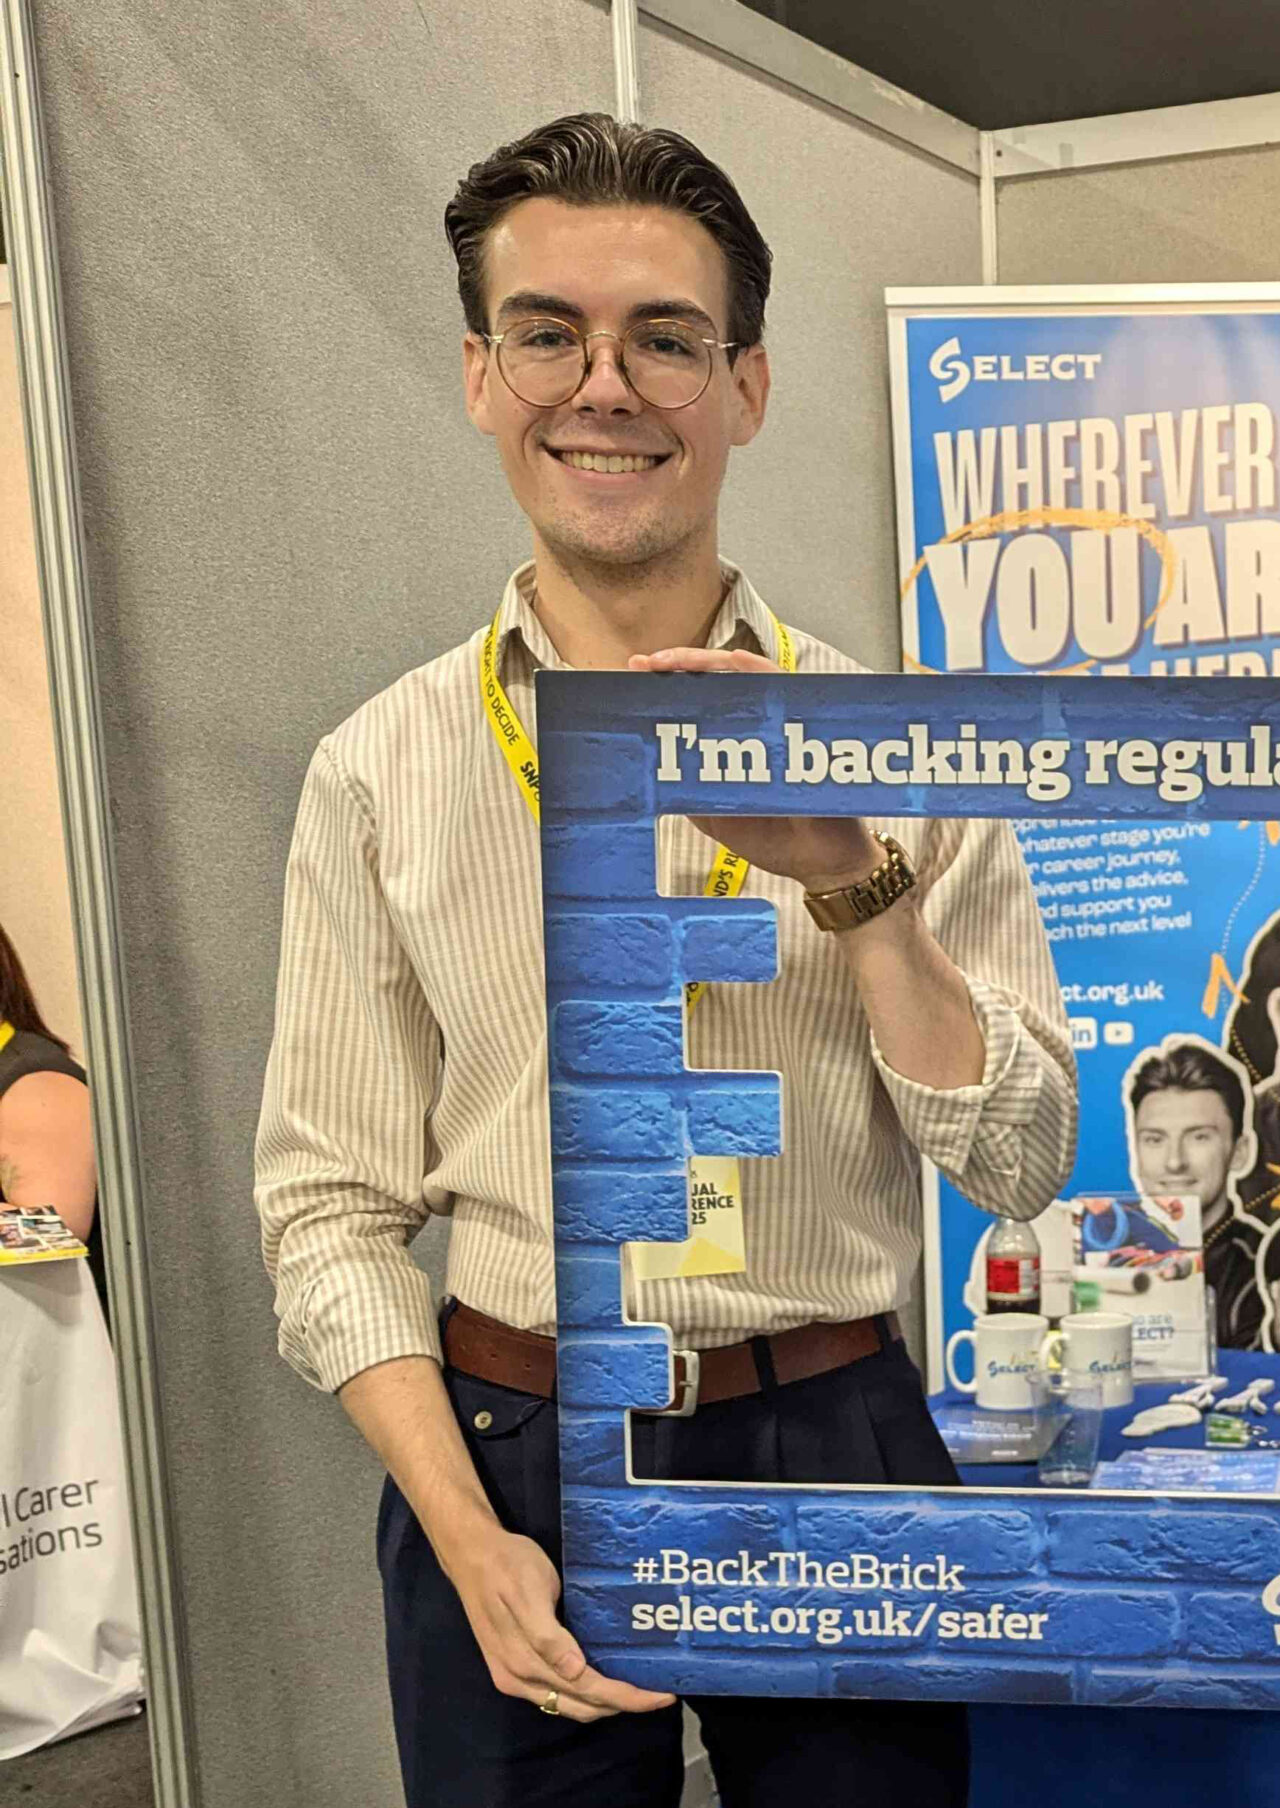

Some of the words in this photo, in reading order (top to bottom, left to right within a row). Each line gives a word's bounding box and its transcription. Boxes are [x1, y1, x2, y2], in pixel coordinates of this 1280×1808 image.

[930, 337, 1101, 403] SELECT
[934, 402, 1277, 534] WHEREVER
[924, 524, 1144, 671] YOU
[491, 697, 519, 746] DECIDE
[656, 723, 771, 783] I'm
[784, 723, 1070, 801] backing
[1100, 830, 1149, 848] stage
[1152, 822, 1211, 845] you're
[1042, 855, 1104, 875] career
[1092, 873, 1123, 892] the
[1061, 896, 1134, 919] support
[1138, 895, 1172, 914] you
[1076, 920, 1106, 938] the
[1109, 916, 1149, 935] next
[1151, 911, 1192, 930] level
[15, 1480, 99, 1522] Carer
[632, 1549, 966, 1591] #BackTheBrick
[632, 1595, 1049, 1645] select.org.uk/safer
